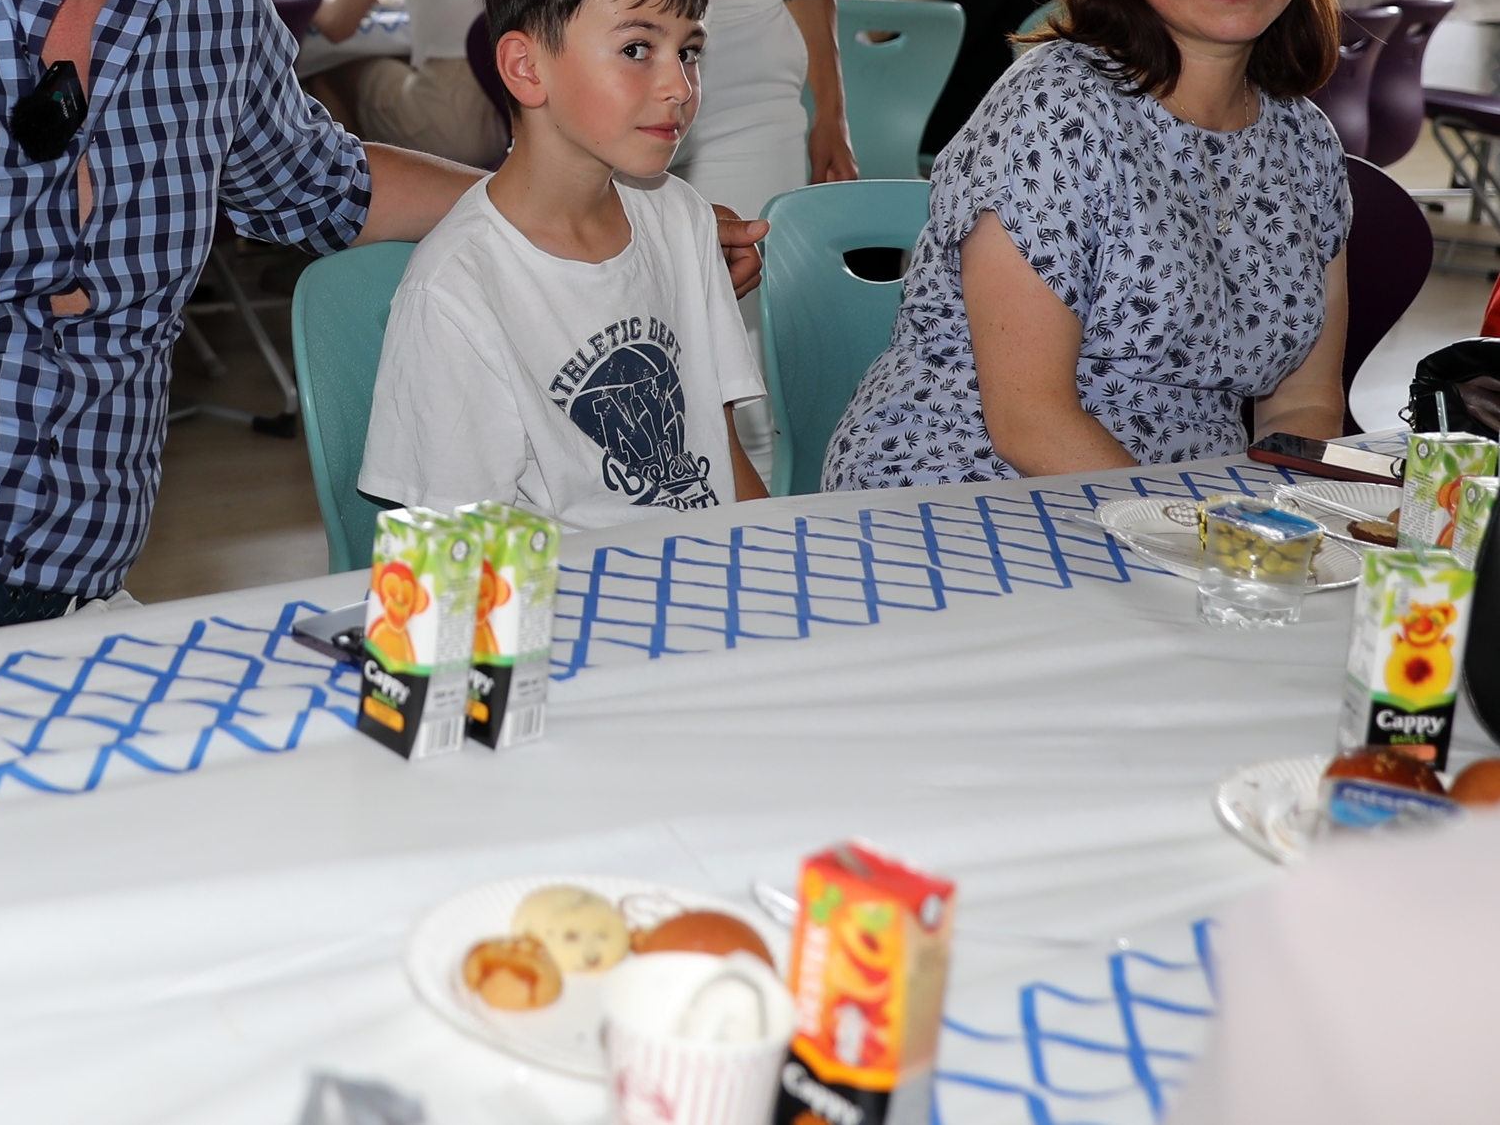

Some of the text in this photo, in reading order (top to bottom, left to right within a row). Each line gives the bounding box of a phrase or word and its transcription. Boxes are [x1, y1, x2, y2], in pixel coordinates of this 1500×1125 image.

[592, 373, 671, 465] NY
[363, 660, 411, 705] Cappy
[1376, 709, 1446, 737] Cappy
